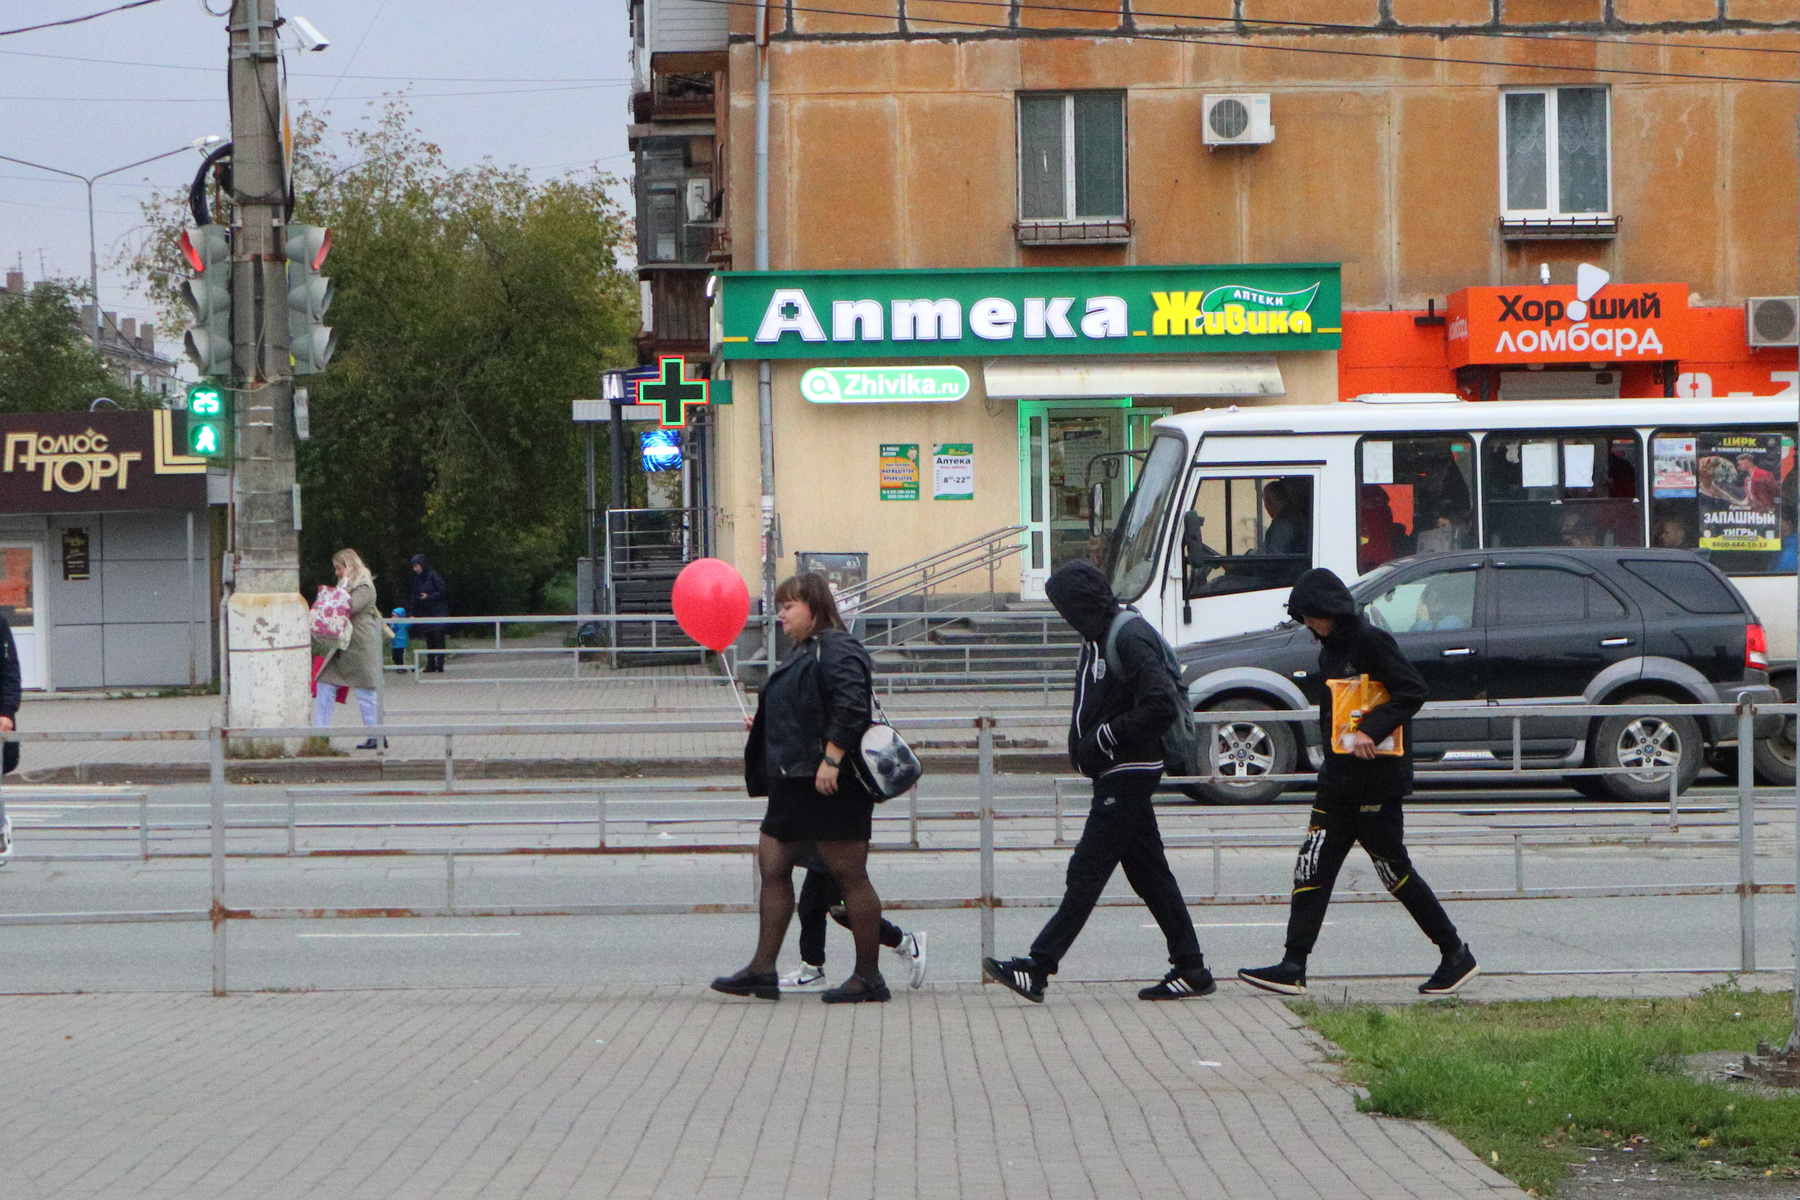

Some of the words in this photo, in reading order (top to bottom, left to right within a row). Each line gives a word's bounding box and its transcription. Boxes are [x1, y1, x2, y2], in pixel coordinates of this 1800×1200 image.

[1233, 289, 1284, 306] АПТЕКИ
[754, 288, 1128, 343] Аптека
[1151, 291, 1312, 336] Живика
[1495, 322, 1663, 357] ломбард
[844, 373, 960, 396] Zhivika.ru
[192, 392, 219, 413] 25
[1722, 437, 1757, 447] ЦИРК
[936, 457, 971, 465] Аптека
[18, 452, 142, 493] ТОРГ
[1703, 510, 1776, 525] ЗАПАШНЫЙ
[1723, 528, 1758, 537] ТИГРЫ
